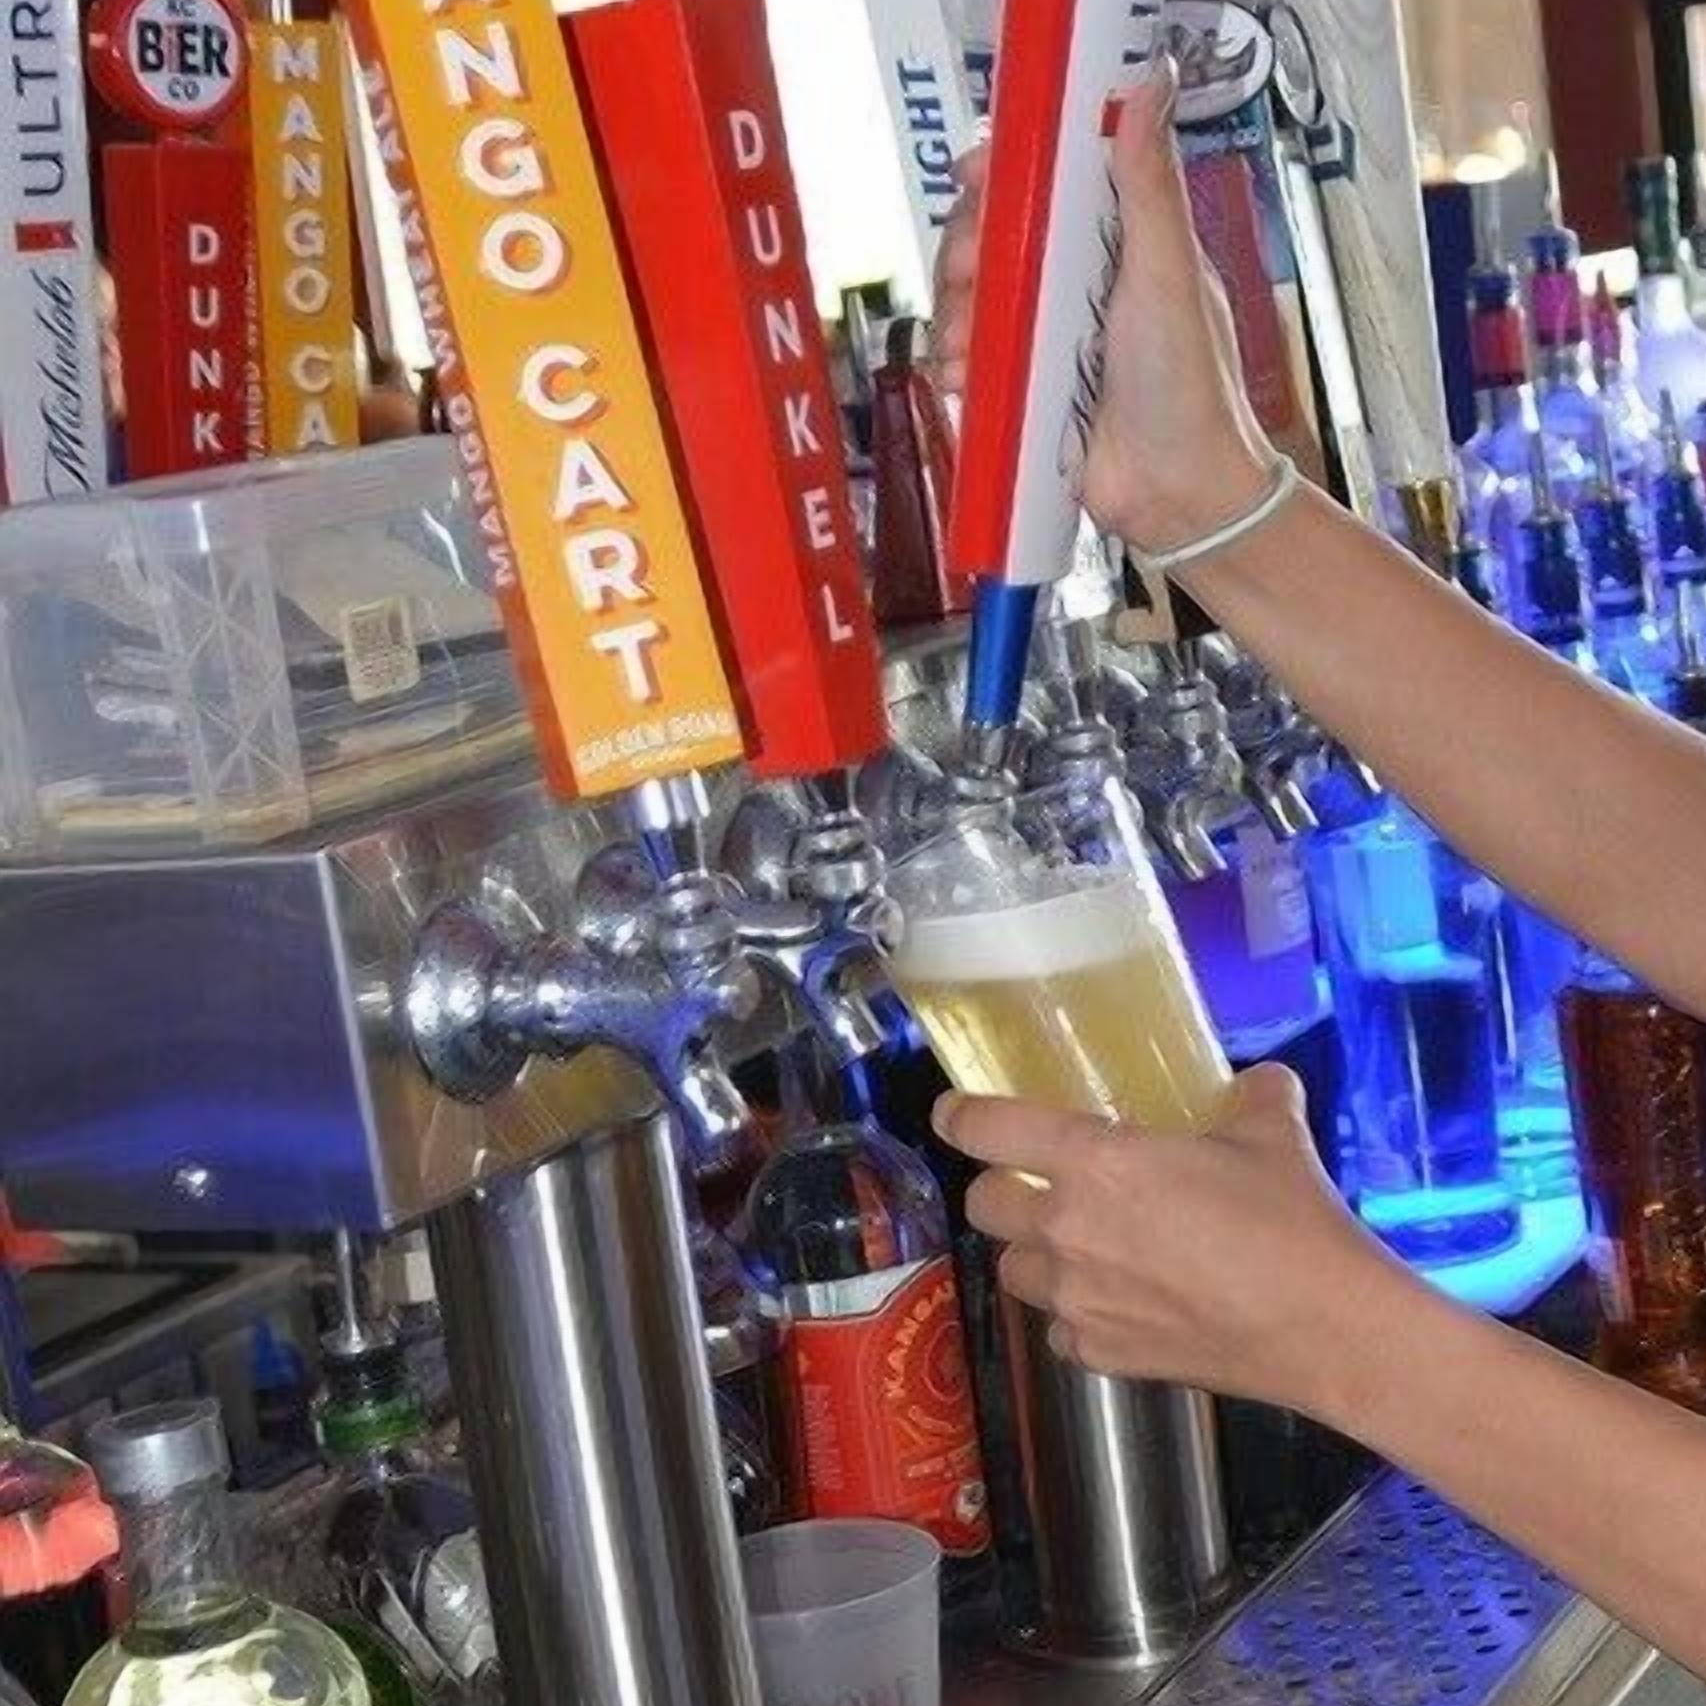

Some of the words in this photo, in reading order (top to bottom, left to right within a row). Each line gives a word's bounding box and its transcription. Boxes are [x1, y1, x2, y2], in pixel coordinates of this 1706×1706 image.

[168, 77, 201, 101] CO
[270, 36, 331, 314] MANGO
[520, 344, 660, 703] CART
[730, 108, 854, 643] DUNKEL
